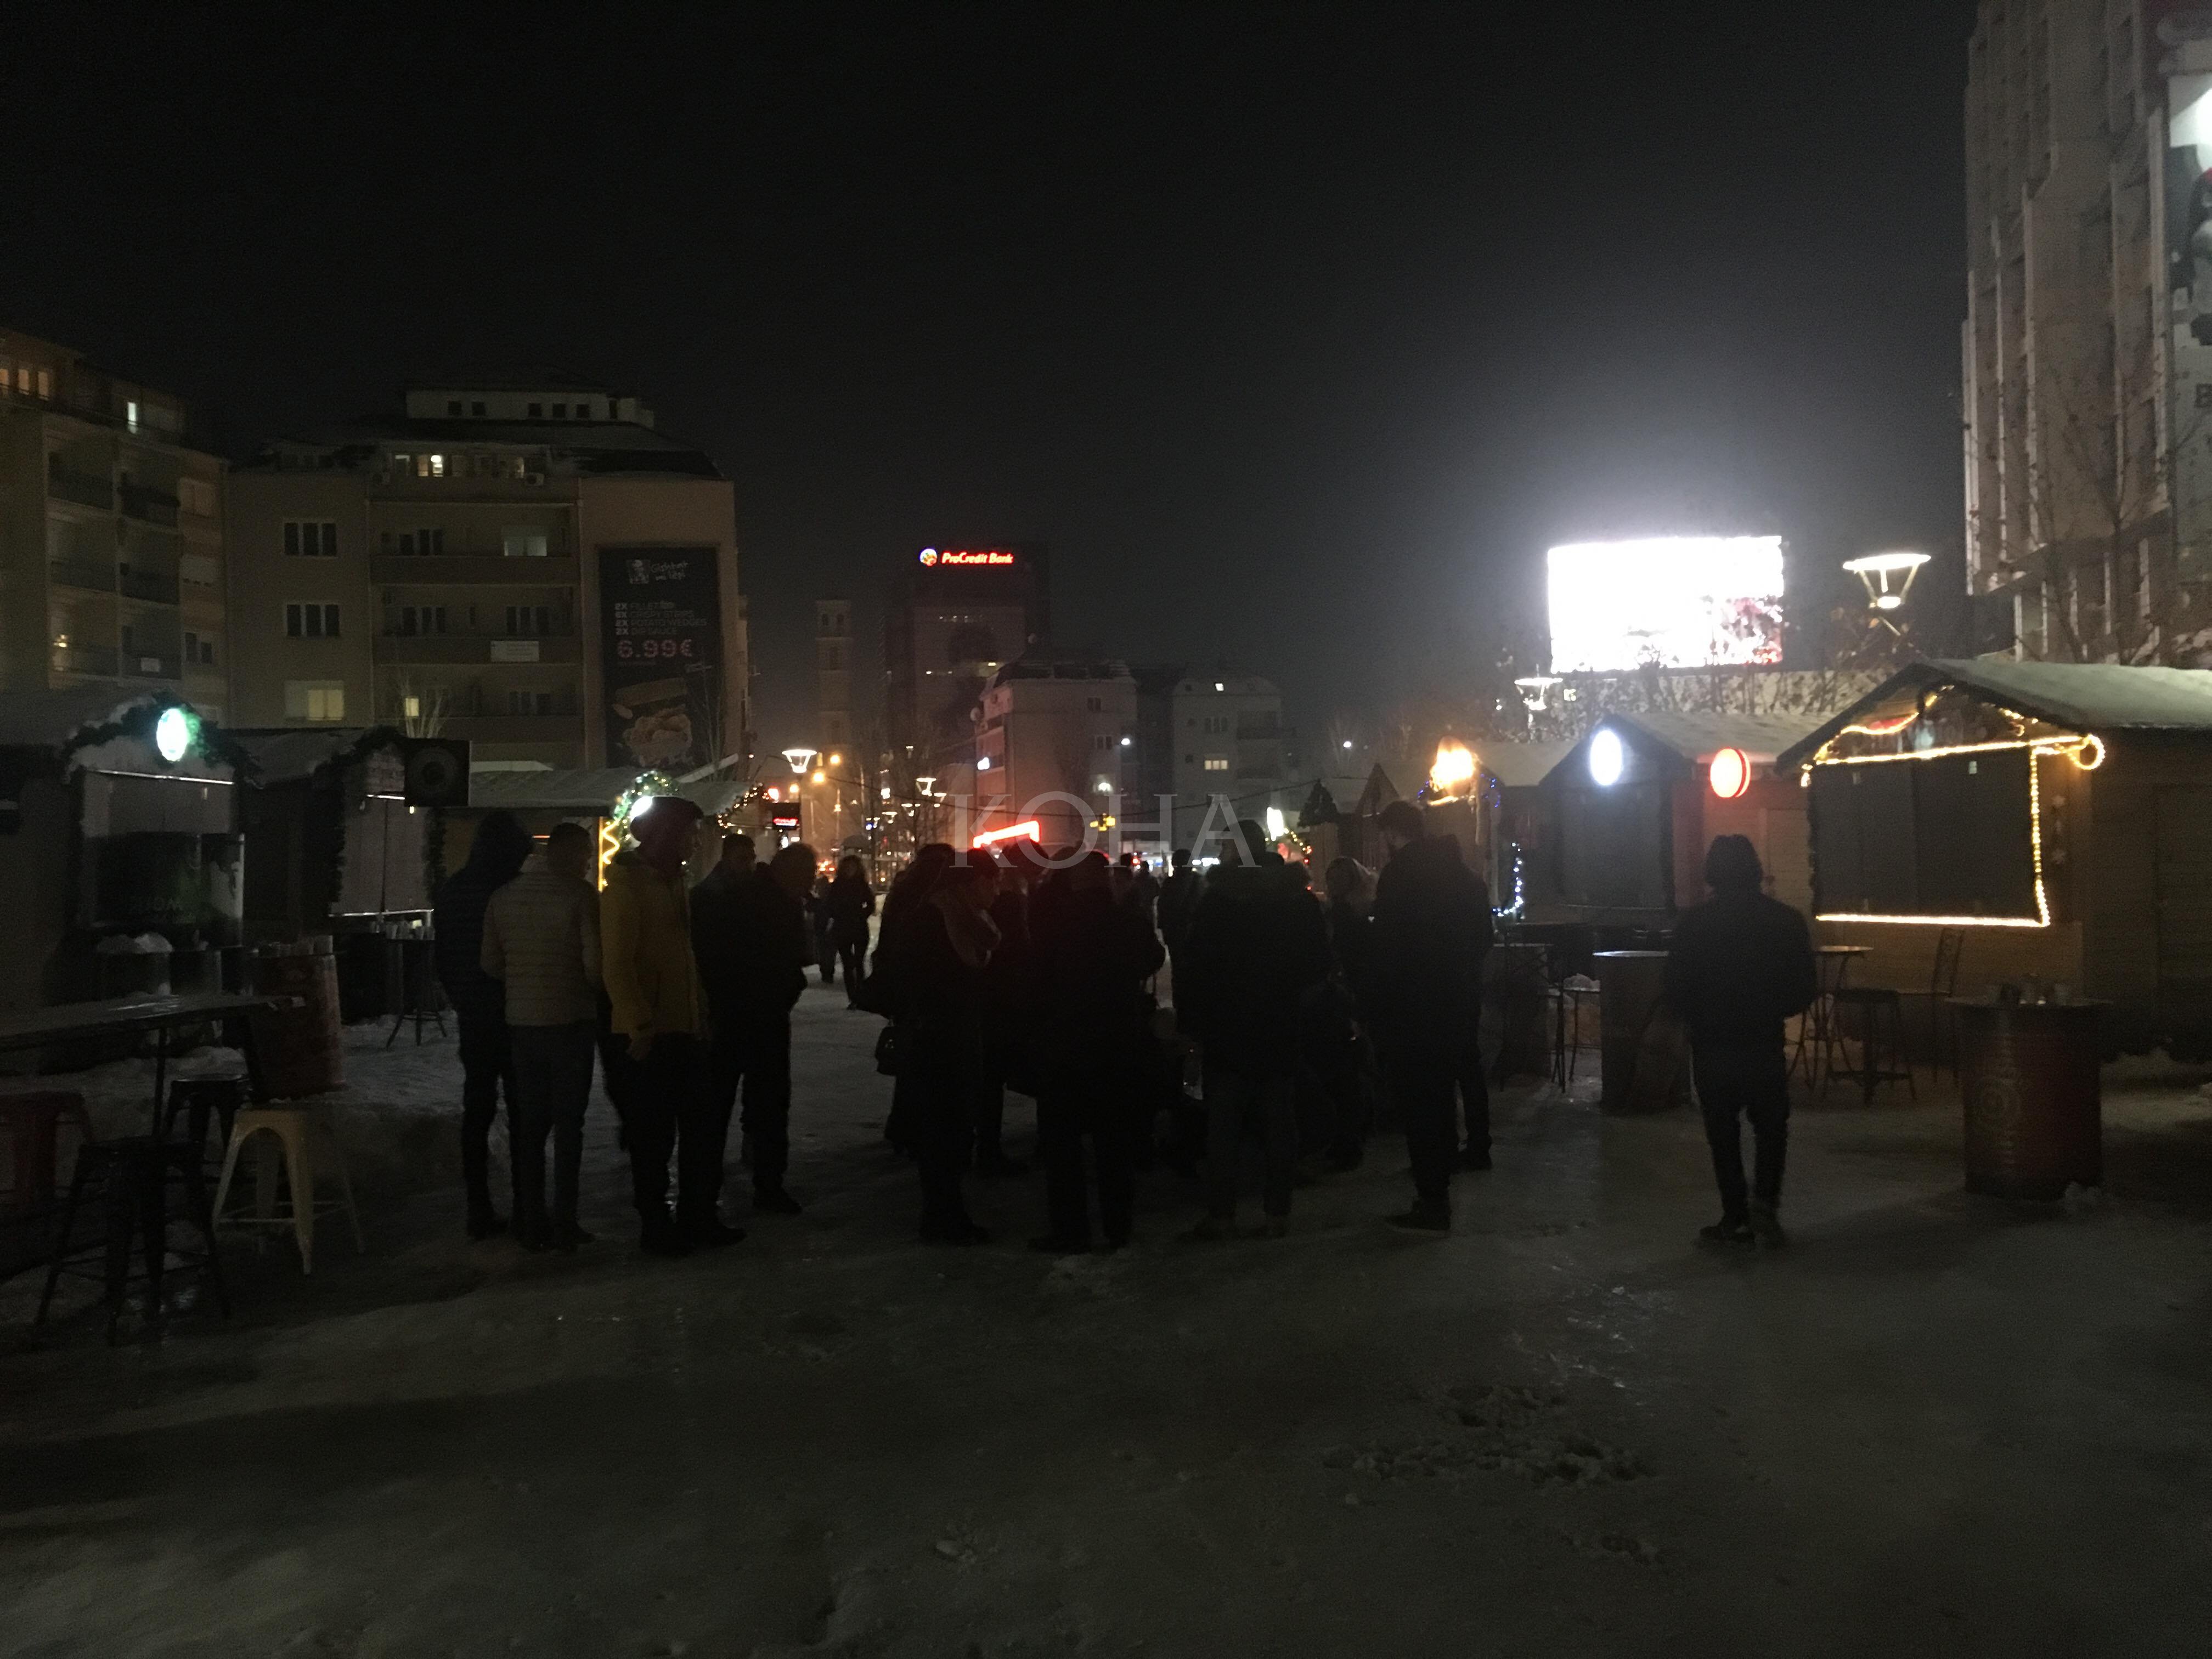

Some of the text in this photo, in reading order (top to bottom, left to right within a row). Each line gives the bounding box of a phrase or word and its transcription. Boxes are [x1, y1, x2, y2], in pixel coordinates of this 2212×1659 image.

[941, 551, 1014, 564] ProCredit Bank
[614, 602, 628, 611] 2X
[630, 618, 668, 627] POTATO
[669, 618, 708, 627] WEDGES
[617, 639, 692, 658] 6.99€
